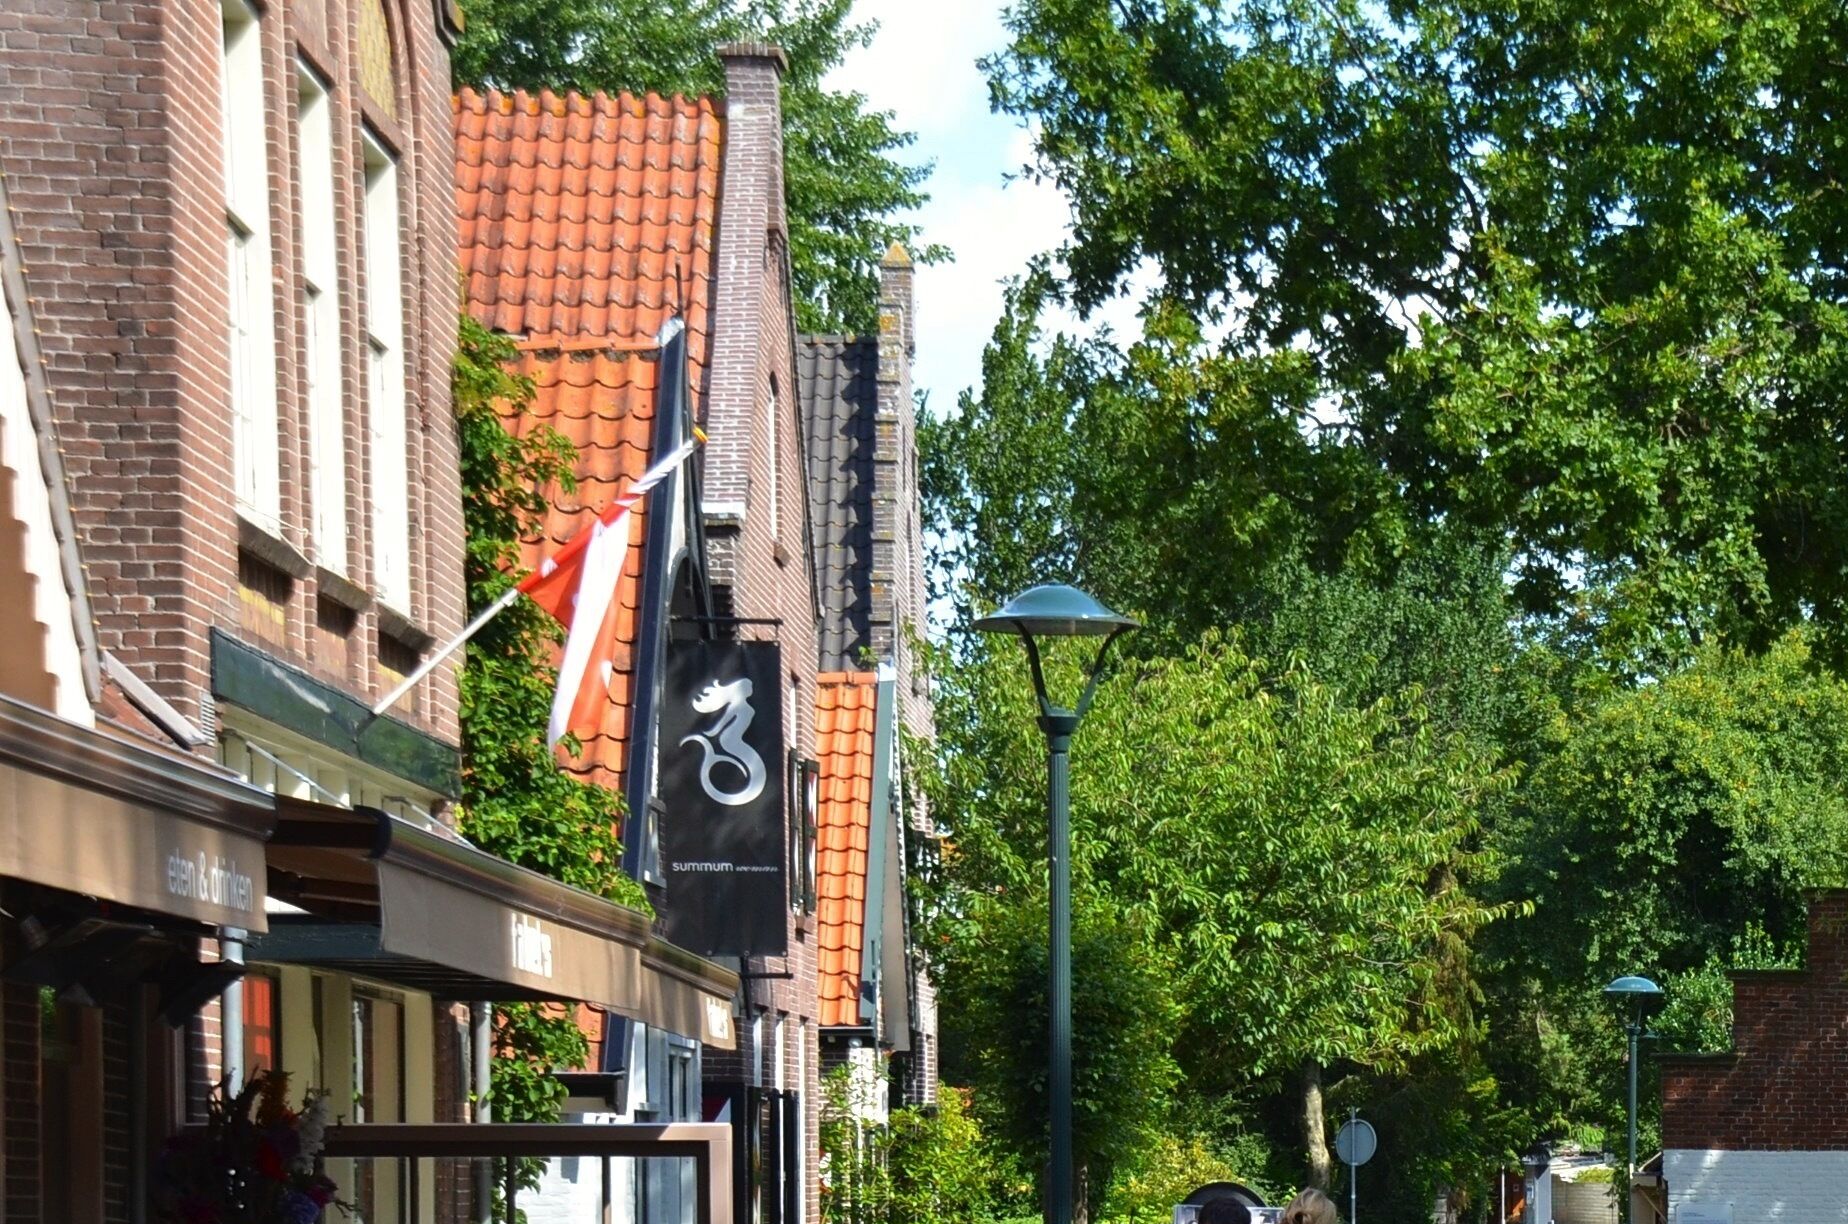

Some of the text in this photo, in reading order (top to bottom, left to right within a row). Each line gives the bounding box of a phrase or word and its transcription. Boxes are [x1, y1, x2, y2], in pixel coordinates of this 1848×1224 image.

[168, 847, 253, 913] eten & drinken
[672, 862, 734, 872] summum
